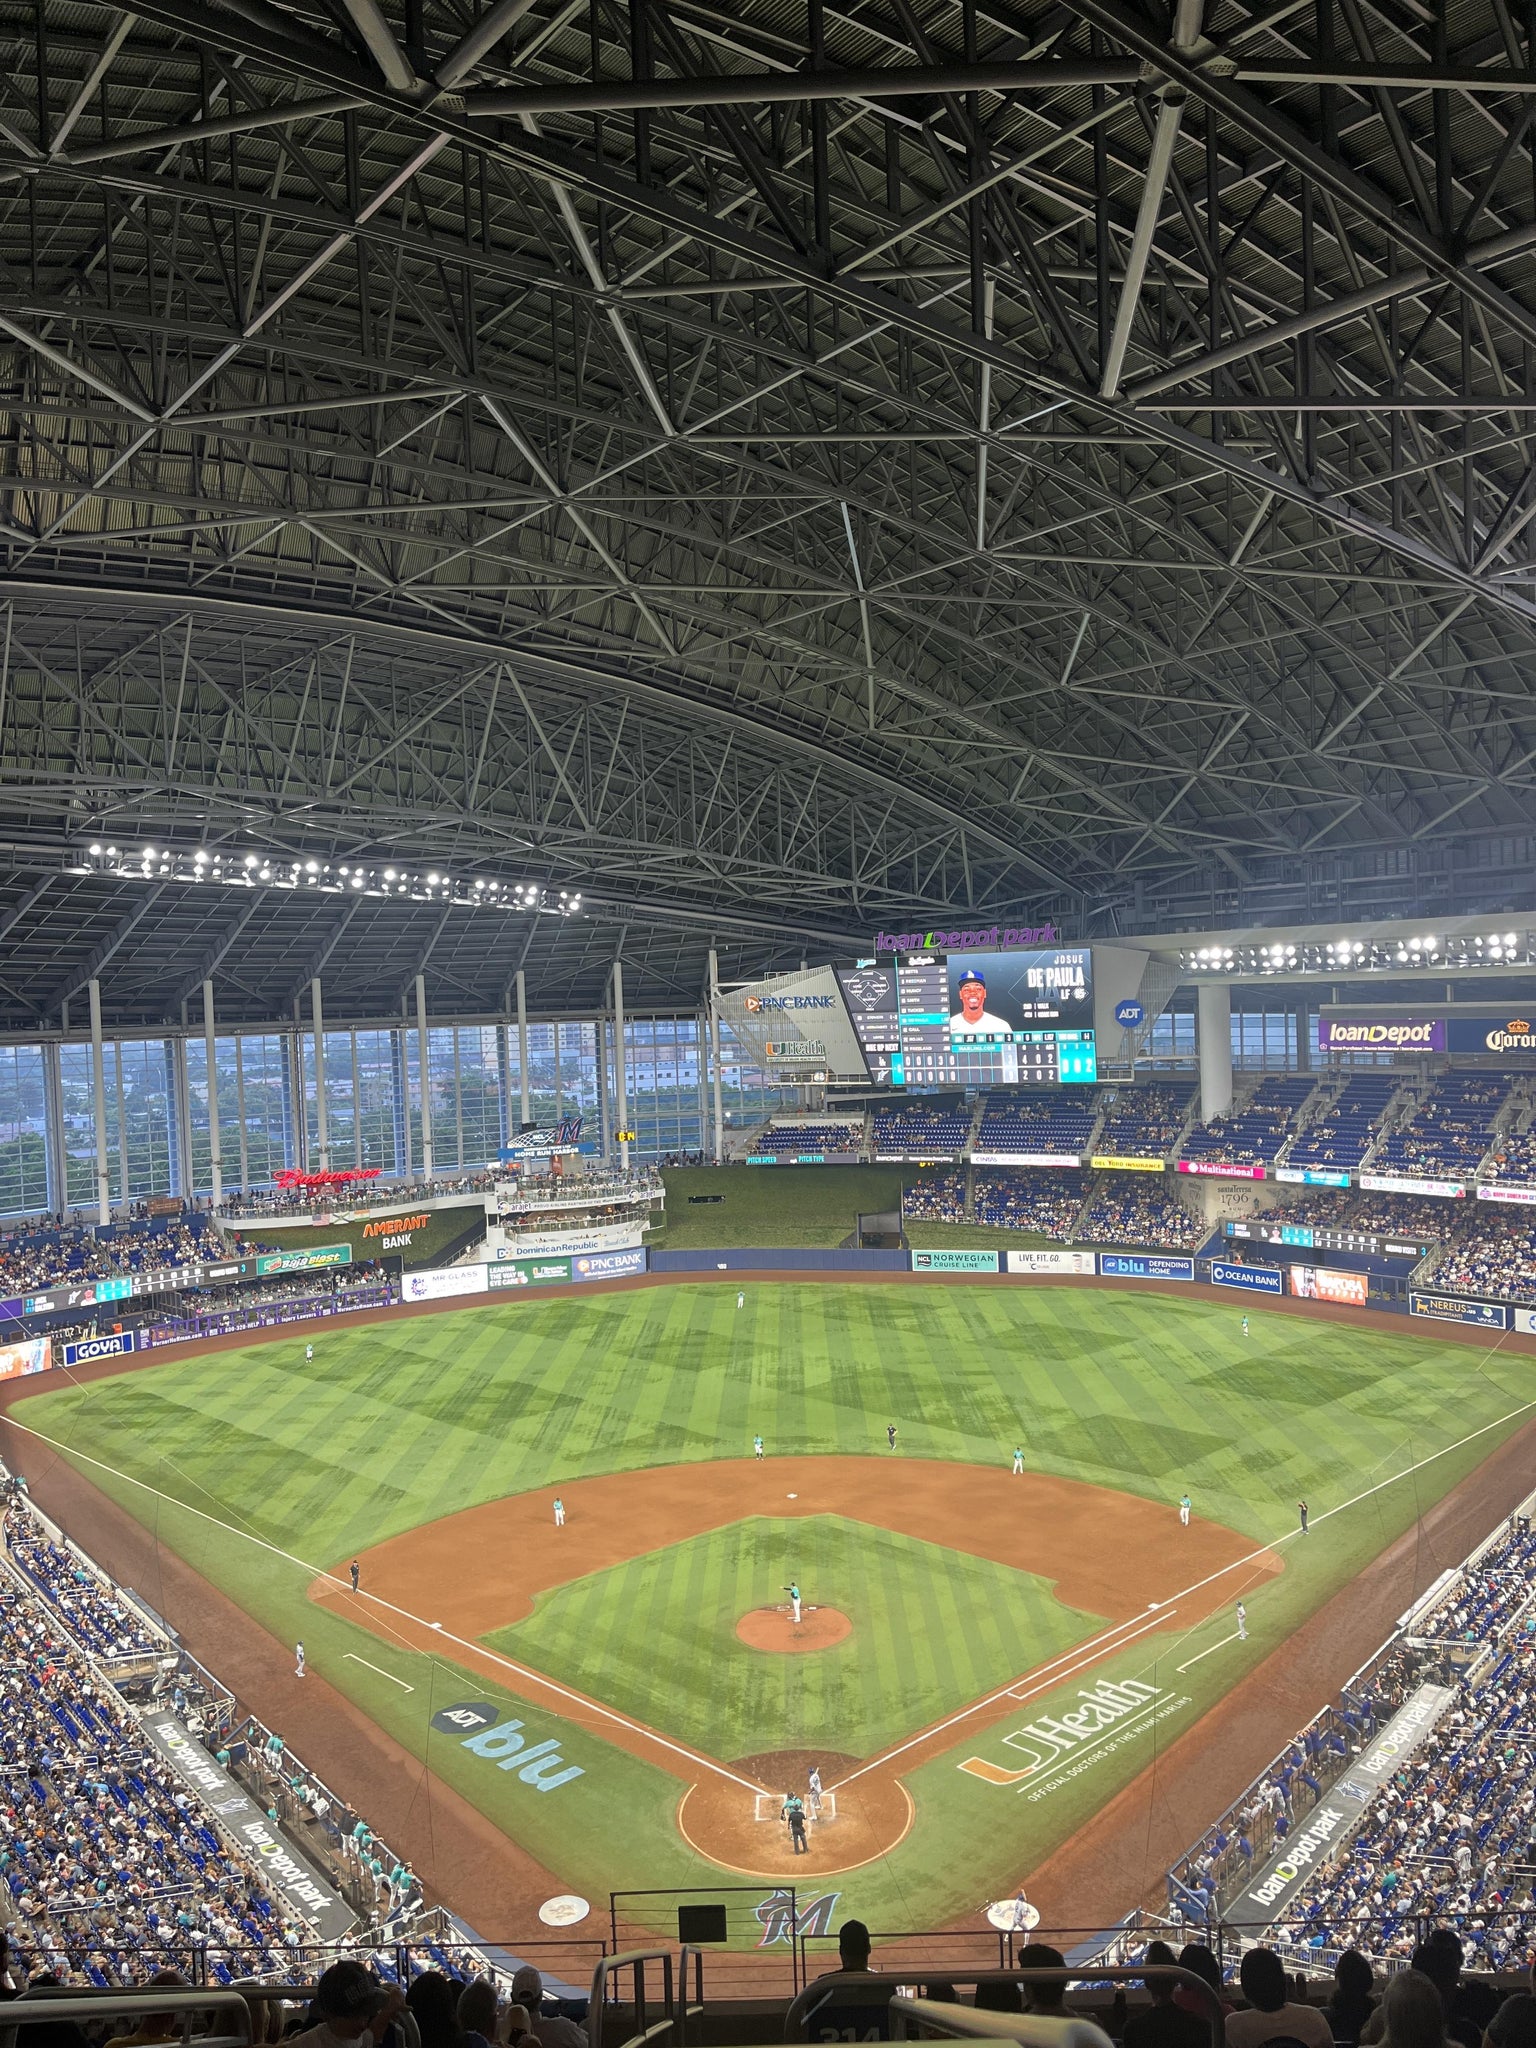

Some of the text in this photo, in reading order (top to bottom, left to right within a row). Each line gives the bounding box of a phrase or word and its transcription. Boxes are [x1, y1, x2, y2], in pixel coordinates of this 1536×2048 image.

[877, 923, 1058, 950] loanDepot park
[1054, 955, 1083, 964] JOSUE
[1027, 966, 1085, 988] DE PAULA
[1061, 989, 1070, 1000] LF
[1119, 1008, 1140, 1019] ADT
[1330, 1023, 1432, 1045] loanDepot
[939, 1056, 943, 1065] 3
[950, 1055, 955, 1065] 0
[1022, 1054, 1027, 1065] 4
[1036, 1054, 1041, 1064] 0
[1048, 1053, 1053, 1063] 2
[1086, 1058, 1093, 1073] 2
[950, 1071, 955, 1081] 0
[1023, 1070, 1028, 1080] 2
[1036, 1070, 1042, 1080] 0
[1048, 1070, 1054, 1080] 2
[1200, 1164, 1253, 1176] Multinational
[273, 1167, 383, 1189] Budweiser
[640, 1190, 655, 1200] arajet
[1221, 1193, 1249, 1206] 1796
[511, 1203, 531, 1213] arajet
[362, 1214, 430, 1238] AMERANT
[382, 1233, 412, 1250] BANK
[1421, 1247, 1427, 1255] 3
[281, 1257, 308, 1268] Baja
[309, 1253, 340, 1264] Blast
[934, 1254, 994, 1262] NORWEGIAN
[242, 1264, 246, 1272] 3
[489, 1265, 515, 1273] LEADING
[1117, 1259, 1144, 1272] blu
[448, 1271, 478, 1280] GLASS
[1225, 1271, 1279, 1286] OCEAN BANK
[337, 1302, 383, 1312] WernerHoffman.com
[1430, 1300, 1467, 1313] NEREUS
[282, 1312, 316, 1323] Injury Lawyers
[152, 1333, 202, 1347] WernerHoffman.com
[78, 1338, 121, 1358] GOYA
[442, 1709, 487, 1728] ADT
[1359, 1700, 1434, 1774] loanDepot park
[460, 1718, 586, 1792] blu
[1027, 1696, 1192, 1802] OFFICIAL DOCTORS OF THE MIAMI MARLINS
[154, 1722, 227, 1791] loanDepot park
[1248, 1808, 1344, 1907] loanDepot park
[241, 1820, 333, 1911] loanDepot park
